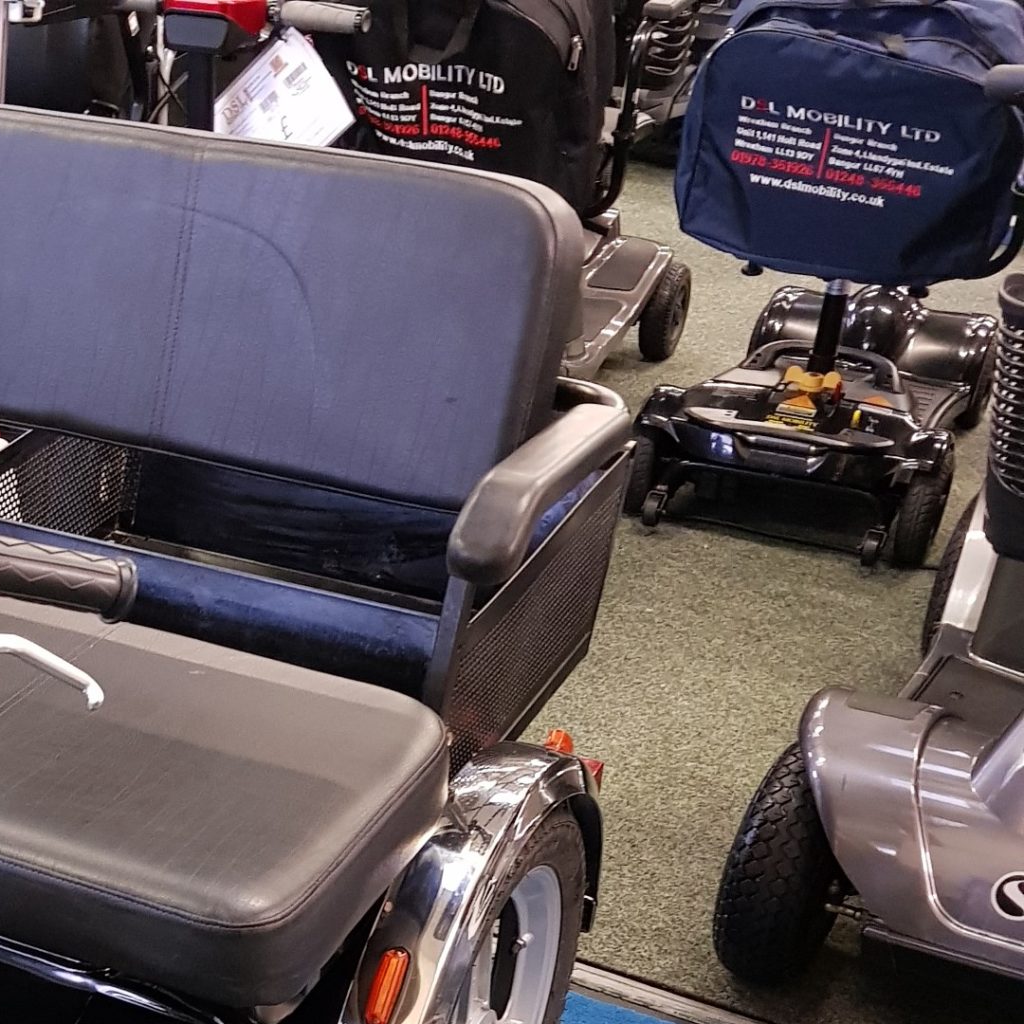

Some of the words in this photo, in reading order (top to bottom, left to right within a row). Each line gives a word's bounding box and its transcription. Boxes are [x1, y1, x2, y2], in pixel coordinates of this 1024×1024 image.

[383, 63, 475, 86] MOBILITY
[479, 71, 505, 94] LTD
[741, 95, 780, 115] DSL
[786, 105, 892, 135] MOBILITY
[900, 125, 941, 143] LTD
